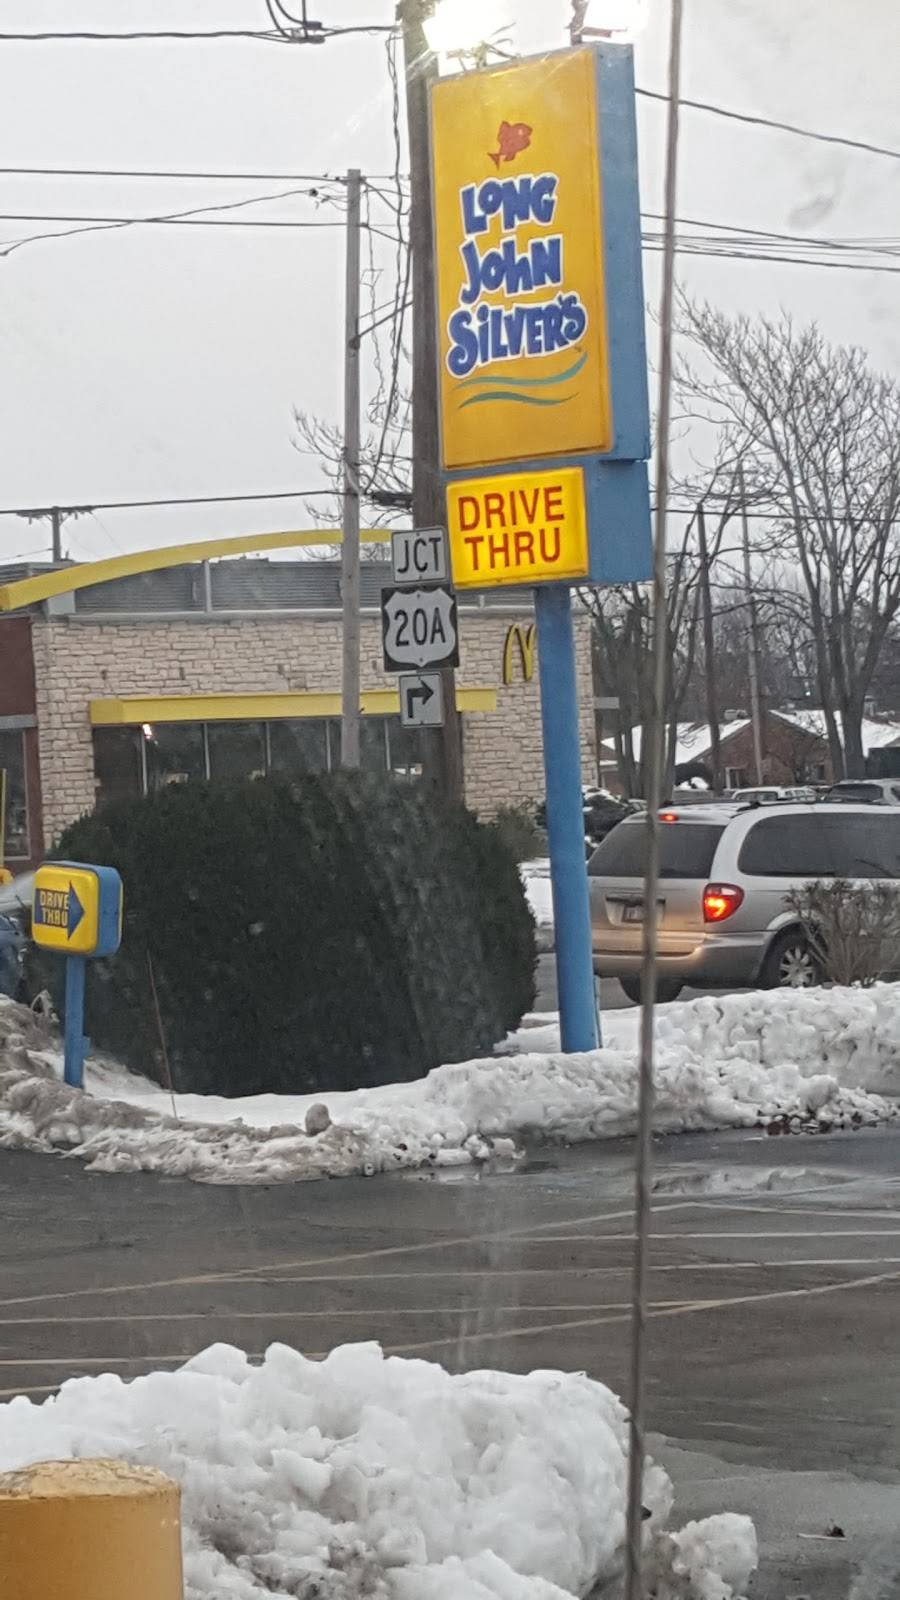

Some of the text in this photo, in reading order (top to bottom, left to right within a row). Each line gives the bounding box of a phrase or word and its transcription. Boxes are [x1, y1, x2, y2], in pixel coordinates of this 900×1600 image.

[461, 174, 558, 235] LONG
[457, 485, 565, 532] DRIVE
[396, 537, 442, 574] JCT
[464, 527, 561, 571] THRU
[393, 607, 446, 648] 20A
[39, 890, 69, 910] DRIVE
[41, 908, 69, 927] THRU
